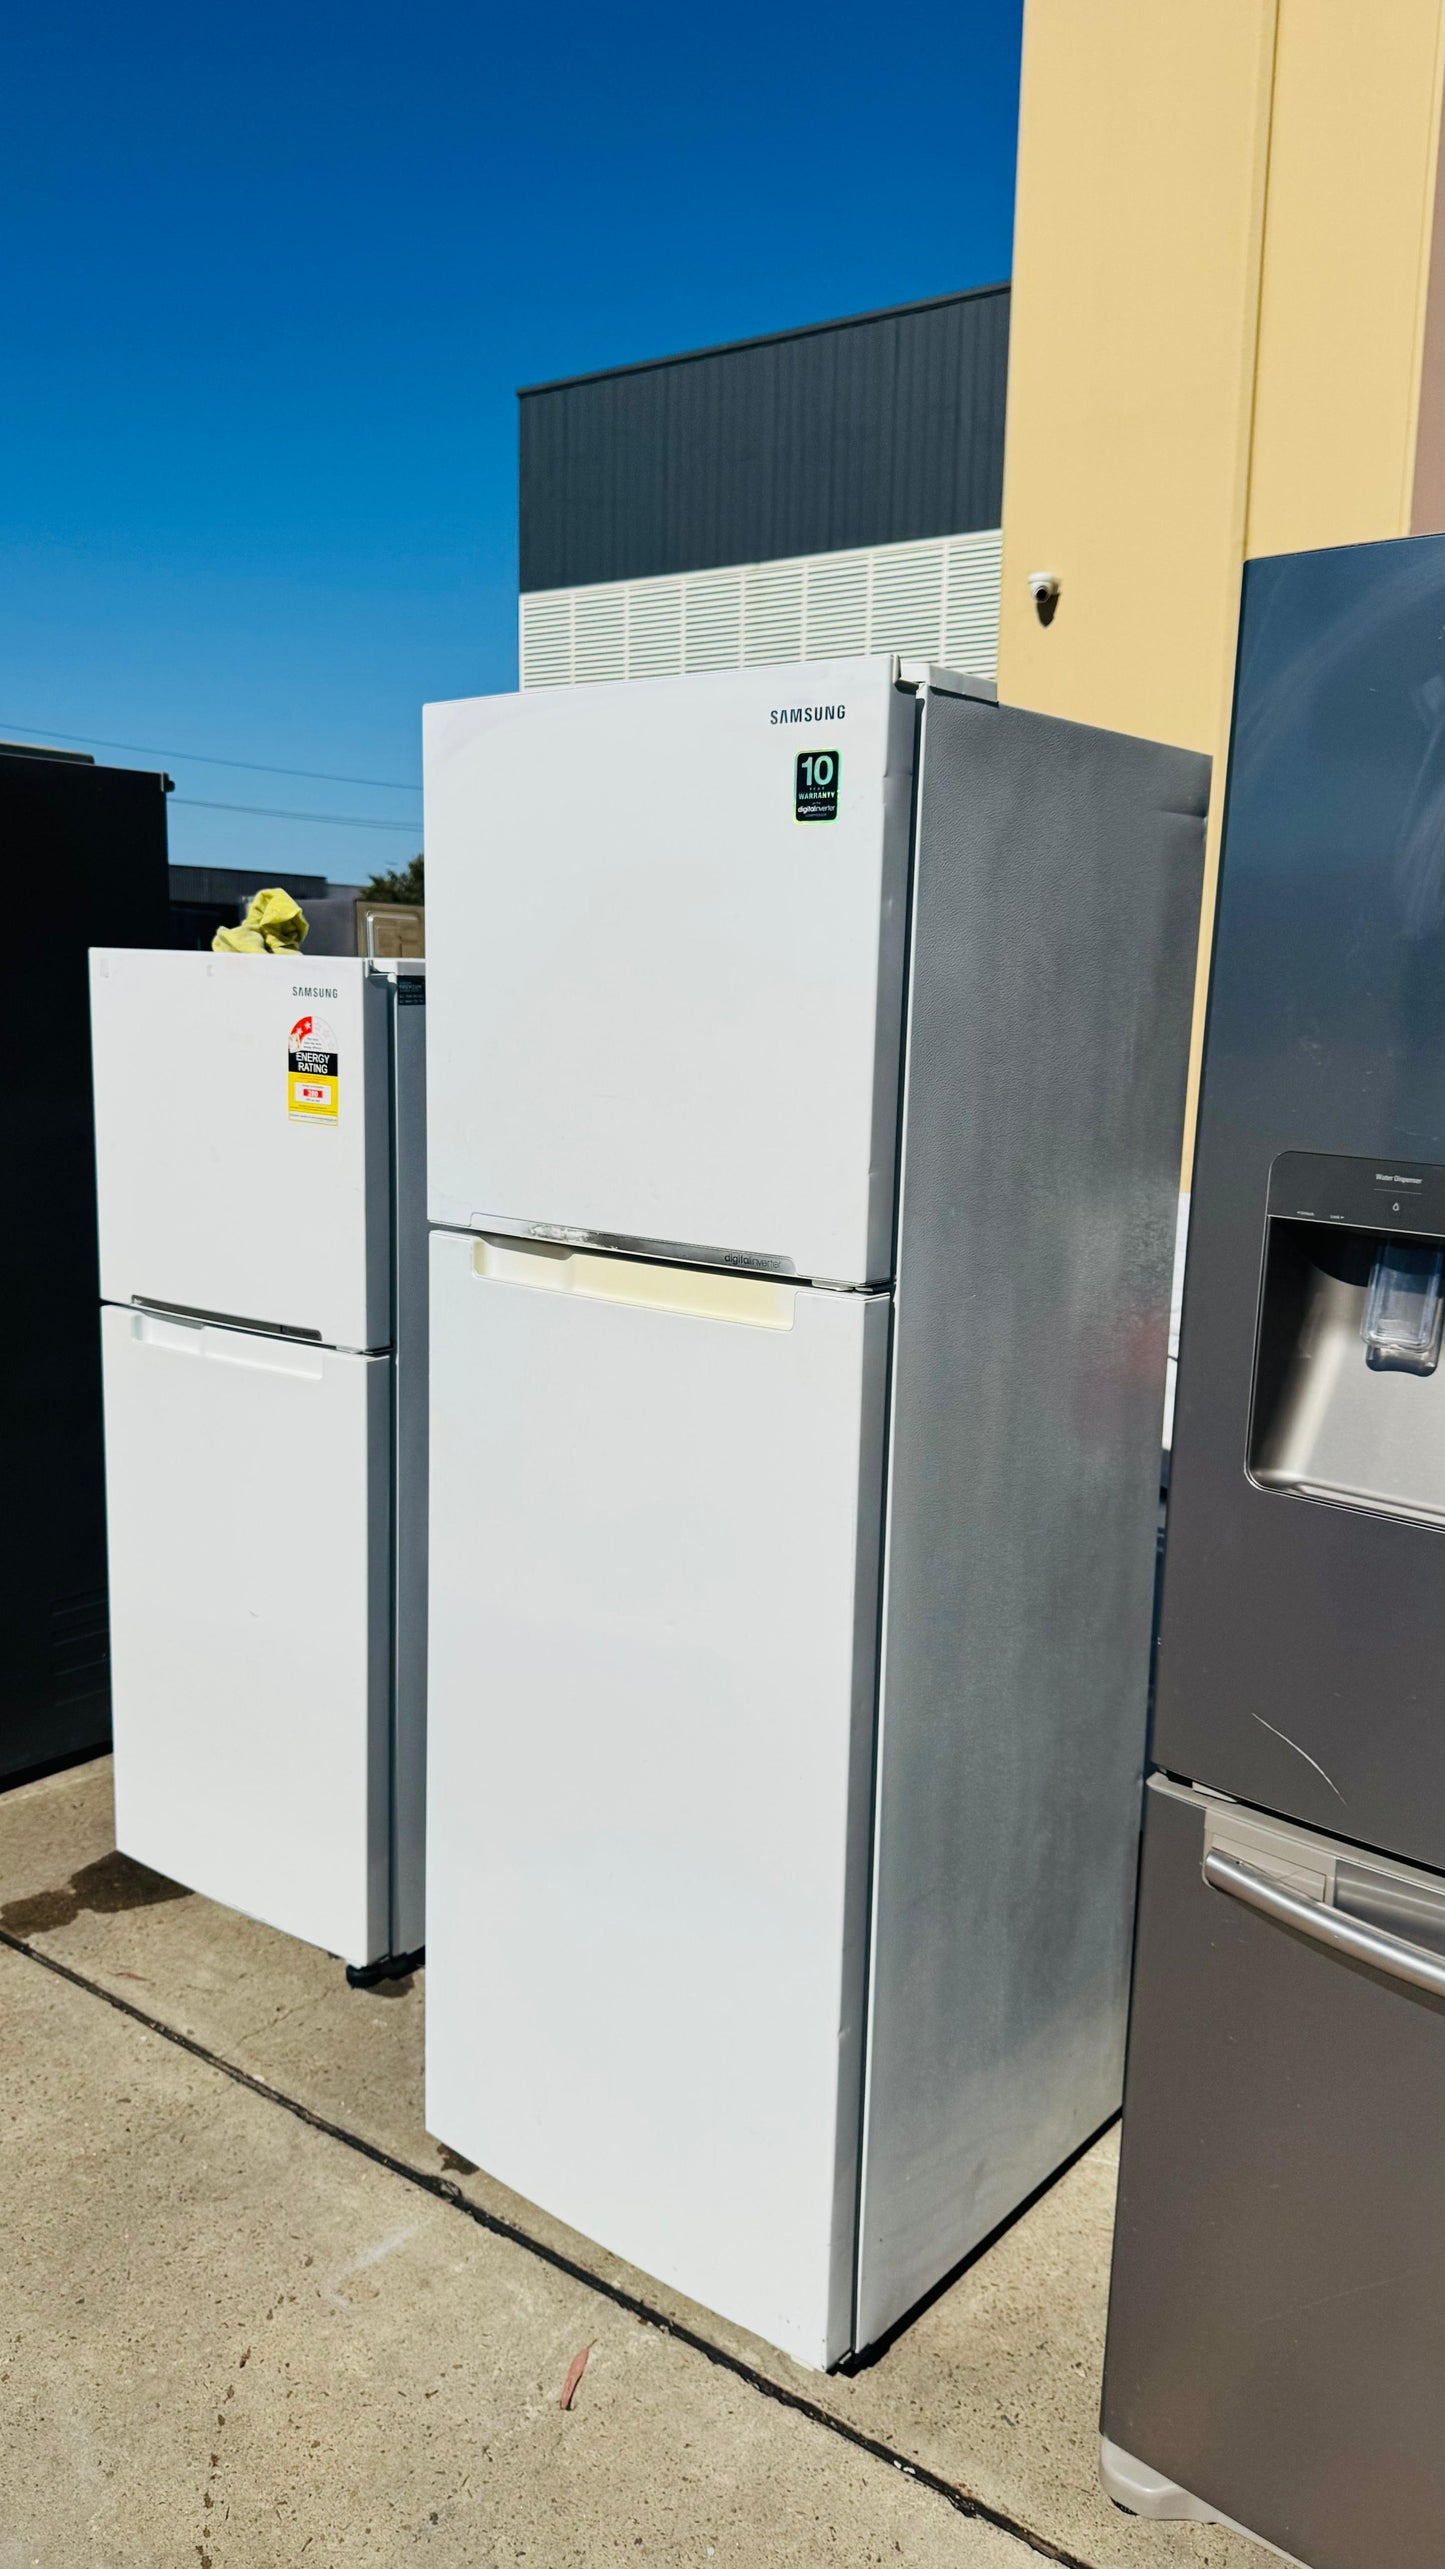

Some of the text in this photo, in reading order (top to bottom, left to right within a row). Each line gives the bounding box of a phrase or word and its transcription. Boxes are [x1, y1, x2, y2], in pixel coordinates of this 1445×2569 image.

[770, 705, 845, 725] SAMSUNG
[801, 755, 834, 786] 10
[798, 791, 835, 800] WARRANTY
[292, 986, 338, 999] SAMSUNG
[295, 1052, 330, 1064] ENERGY
[297, 1061, 328, 1074] RATING
